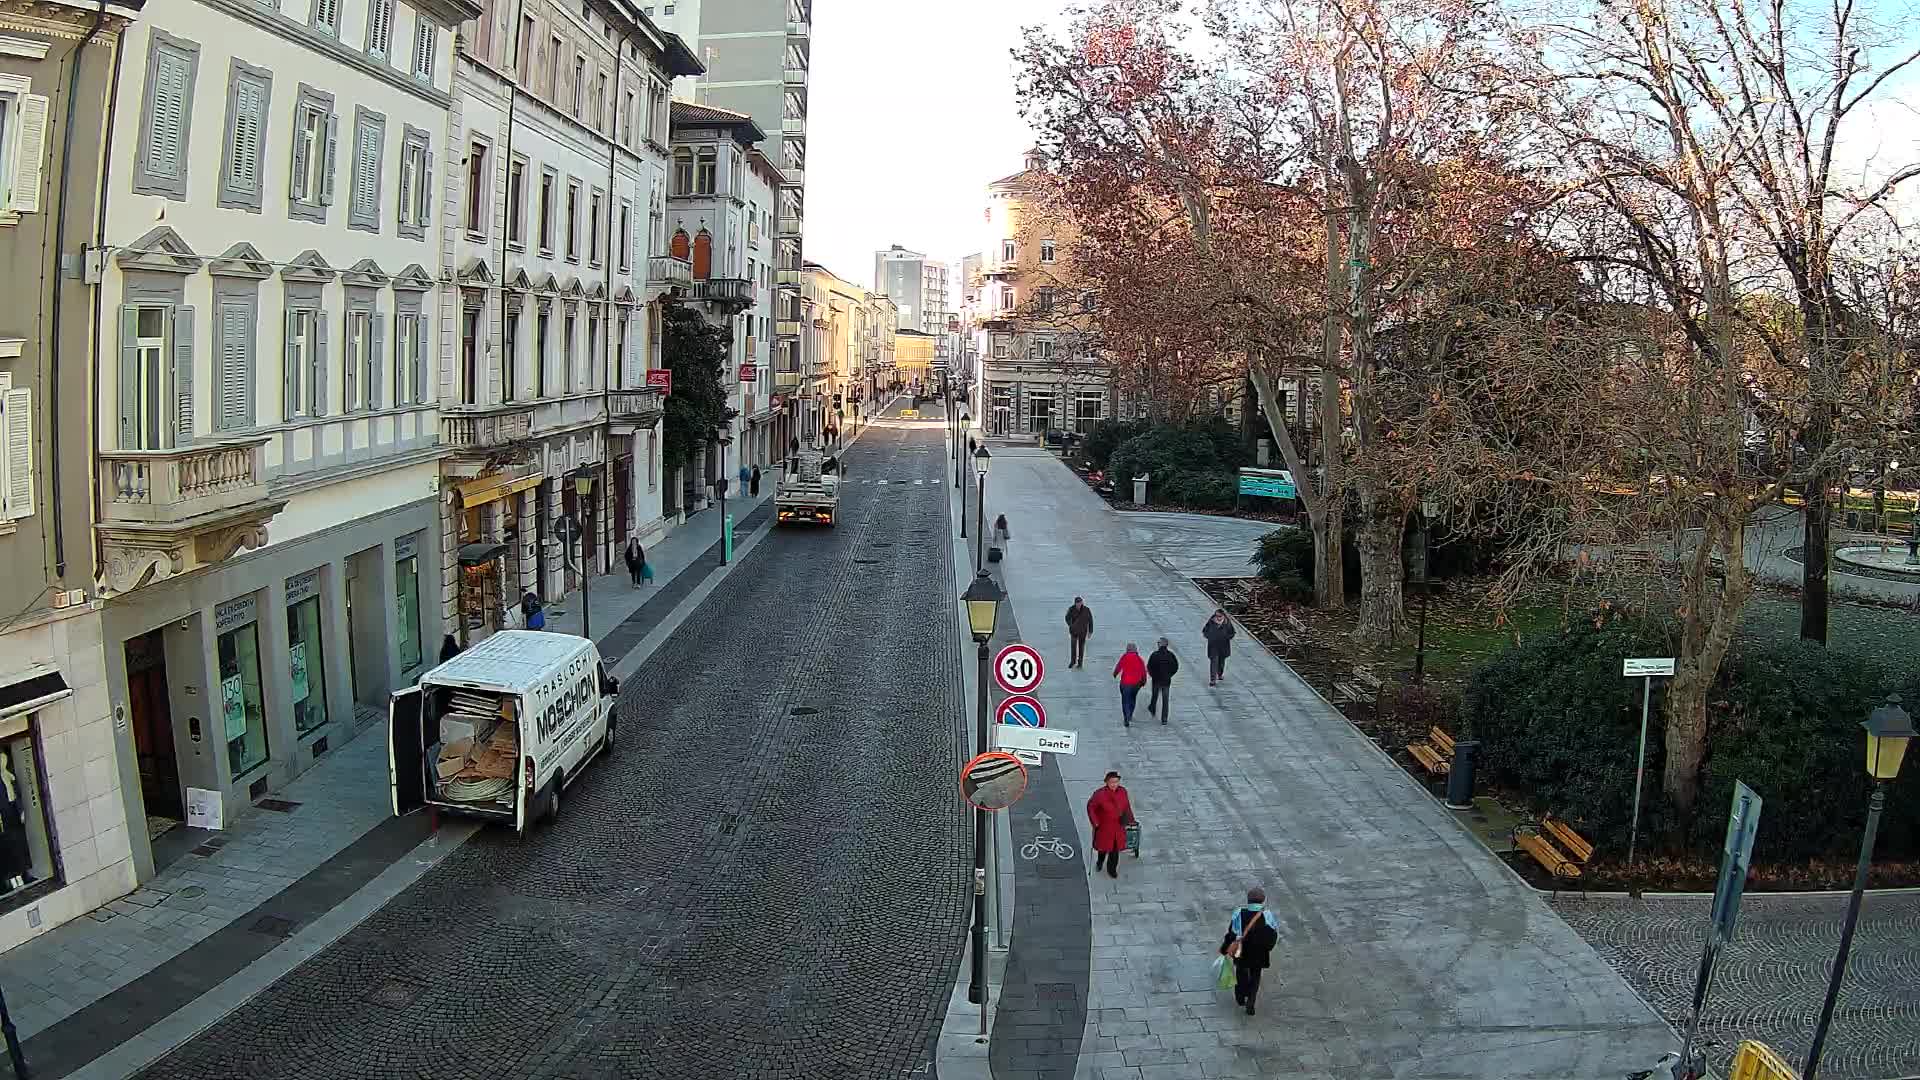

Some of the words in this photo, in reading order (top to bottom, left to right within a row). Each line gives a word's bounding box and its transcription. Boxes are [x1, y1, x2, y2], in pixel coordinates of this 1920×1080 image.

[536, 652, 592, 703] TRASLOCHI
[1006, 658, 1033, 681] 30
[536, 670, 596, 744] MOSCHION
[1038, 737, 1070, 749] Dante
